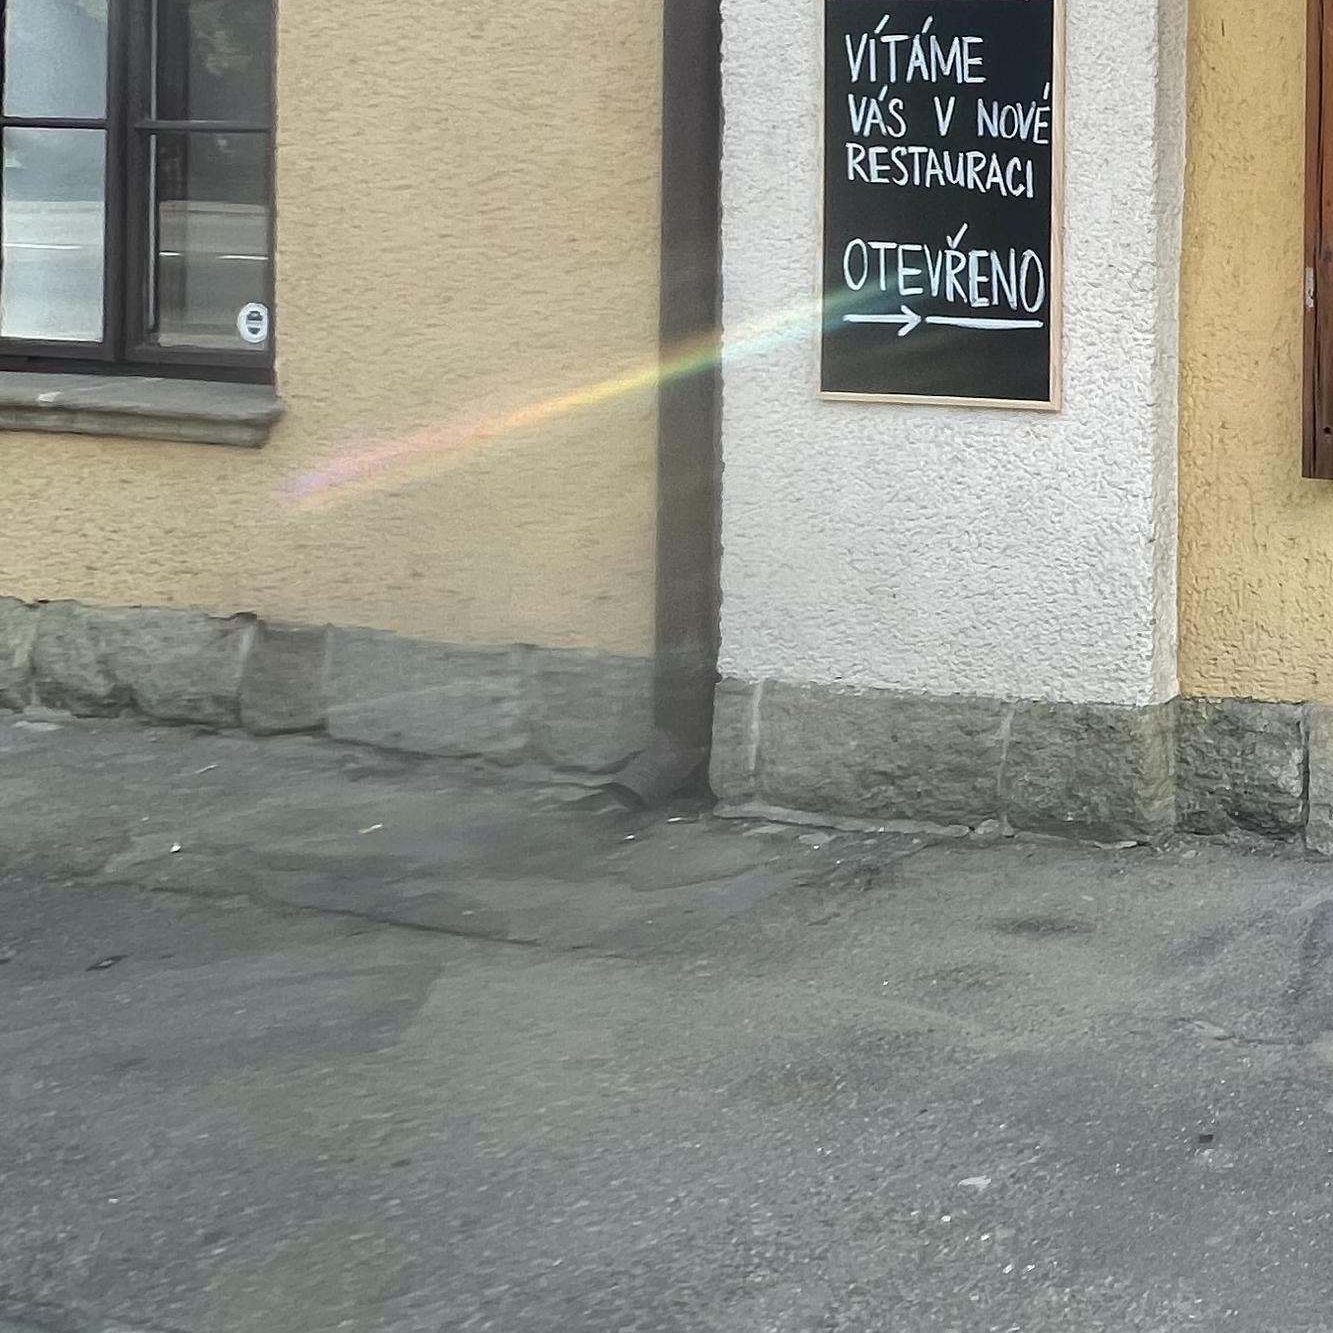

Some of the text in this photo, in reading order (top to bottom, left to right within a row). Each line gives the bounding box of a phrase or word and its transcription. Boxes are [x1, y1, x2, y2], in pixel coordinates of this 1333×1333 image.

[845, 13, 987, 84] VÍTÁME
[848, 82, 1050, 145] VÁS V NOVÉ
[846, 142, 1035, 199] RESTAURACI
[843, 222, 1045, 314] OTEVŘENO
